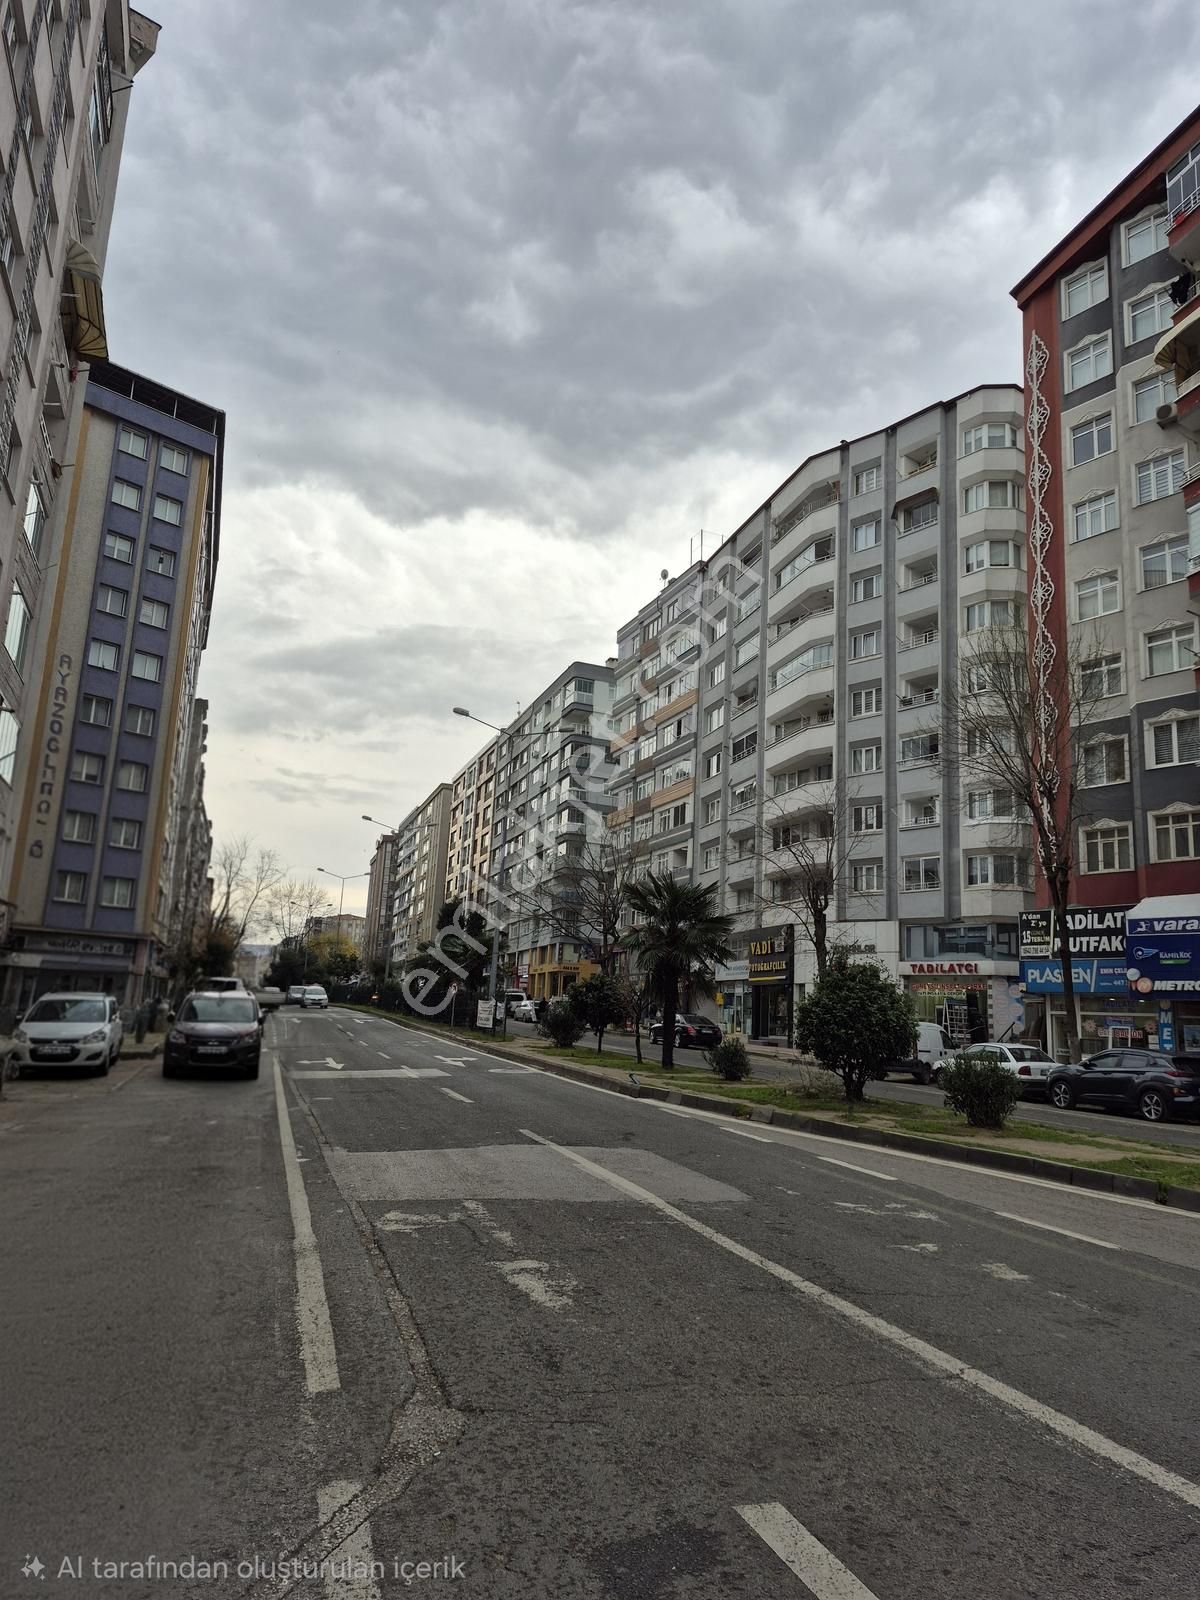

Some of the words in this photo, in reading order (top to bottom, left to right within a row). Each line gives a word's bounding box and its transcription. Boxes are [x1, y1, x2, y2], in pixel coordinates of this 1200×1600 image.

[1054, 909, 1124, 931] ADİLAT
[1153, 919, 1200, 931] vara
[1022, 930, 1031, 943] 15
[1054, 935, 1126, 952] MUTFAK
[750, 936, 771, 955] VADİ
[1027, 966, 1091, 984] PLASEN
